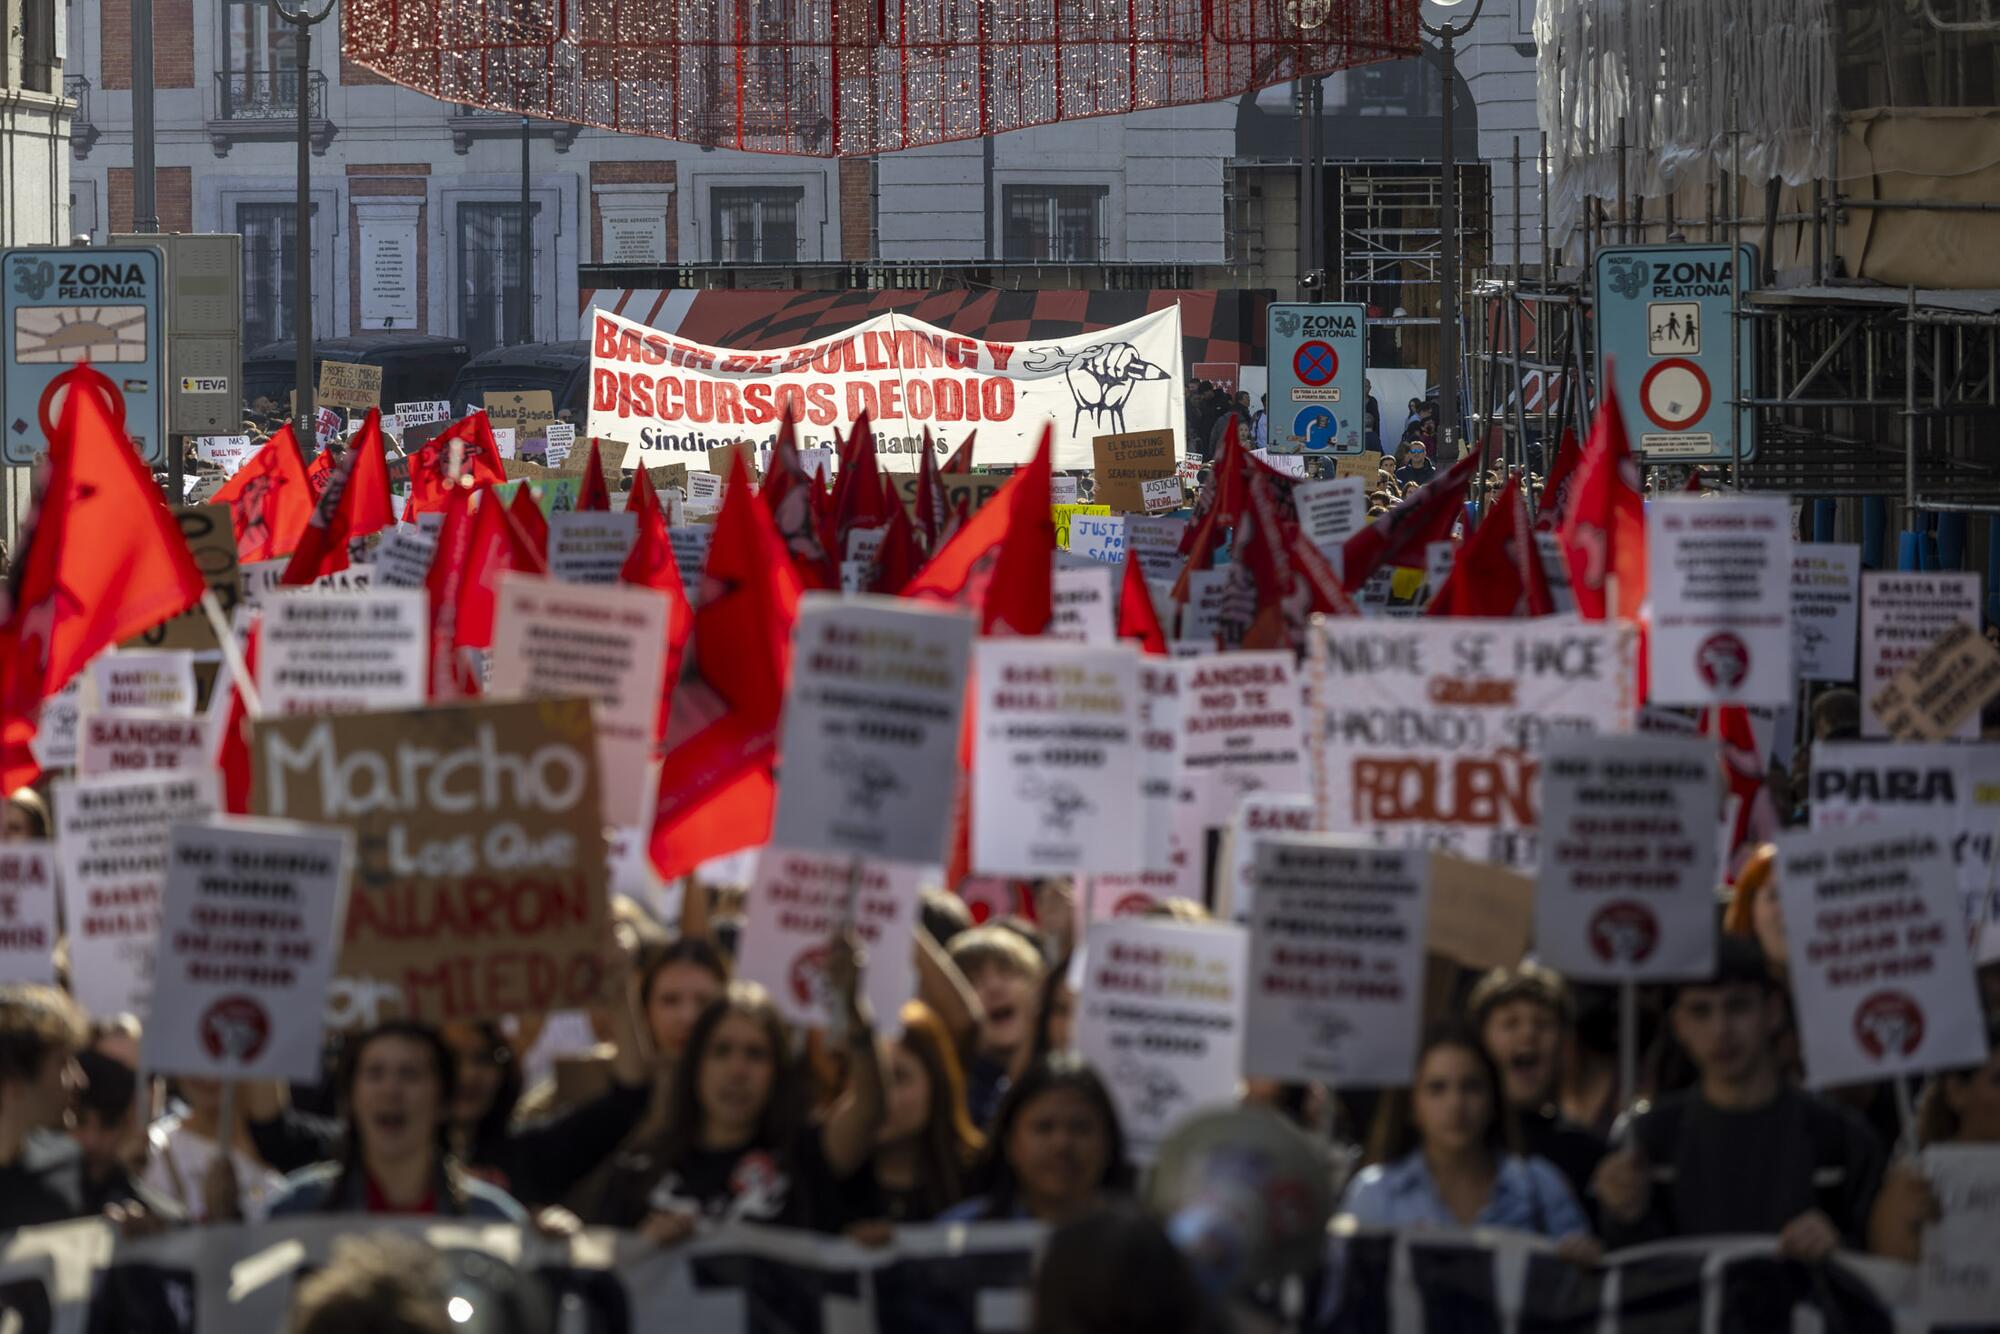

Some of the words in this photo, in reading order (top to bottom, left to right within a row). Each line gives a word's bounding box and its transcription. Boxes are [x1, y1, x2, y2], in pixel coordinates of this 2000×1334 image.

[58, 263, 146, 286] ZONA
[1653, 261, 1734, 285] ZONA
[58, 286, 146, 299] PEATONAL
[1653, 284, 1732, 298] PEATONA
[1302, 315, 1357, 330] ZONA
[1302, 329, 1358, 338] PEATONAL
[594, 315, 717, 371] BASTA
[780, 329, 978, 375] BULLYING
[984, 341, 1015, 371] Y
[194, 379, 226, 391] TEVA
[593, 367, 839, 427] DISCURSOS
[396, 402, 434, 414] HUMILLAR
[438, 402, 445, 411] A
[404, 412, 434, 423] LGUIEN
[438, 411, 450, 421] NO
[211, 448, 242, 457] BULLYING
[1107, 441, 1118, 451] EL
[1120, 436, 1163, 449] BULLYING
[1115, 450, 1126, 461] ES
[1144, 477, 1180, 493] JUSTICIA
[1088, 548, 1125, 565] SAND
[1877, 581, 1935, 596] BASTA
[1940, 581, 1965, 595] DE
[1874, 626, 1945, 641] PRIVAD
[1452, 632, 1494, 675] SE
[1514, 634, 1603, 682] HACE
[1191, 664, 1287, 689] ANDRA
[1201, 691, 1238, 709] NO
[1243, 690, 1267, 706] TE
[89, 722, 203, 749] SANDRA
[110, 750, 146, 770] NO
[153, 750, 181, 769] TE
[264, 719, 590, 822] Marcho
[1351, 745, 1542, 828] PEQUEÑ
[1814, 766, 1957, 804] PARA
[387, 822, 476, 878] Los
[483, 820, 578, 872] Que
[323, 974, 397, 1030] or
[403, 950, 602, 1020] MIEDO
